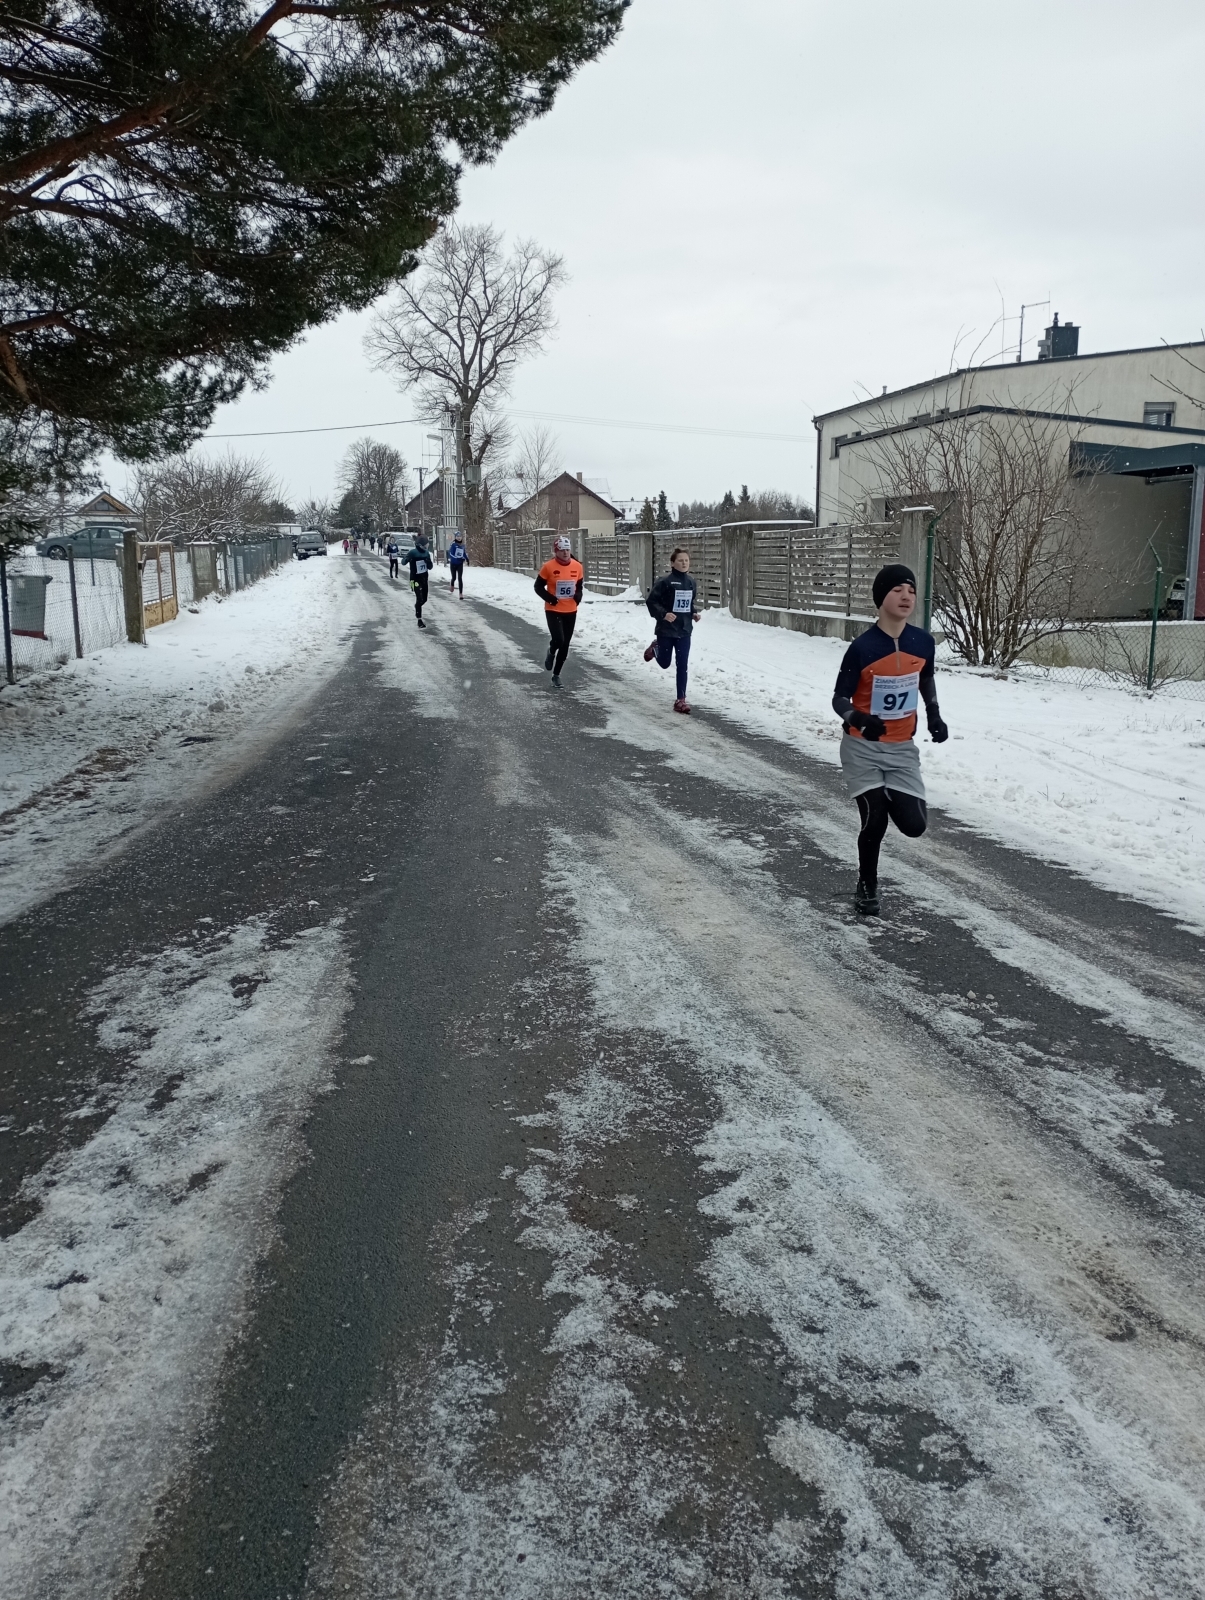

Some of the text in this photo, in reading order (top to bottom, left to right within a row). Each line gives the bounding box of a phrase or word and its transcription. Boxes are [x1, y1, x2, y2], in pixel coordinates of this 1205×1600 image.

[560, 587, 571, 595] 56
[677, 599, 690, 608] 139
[883, 691, 909, 711] 97
